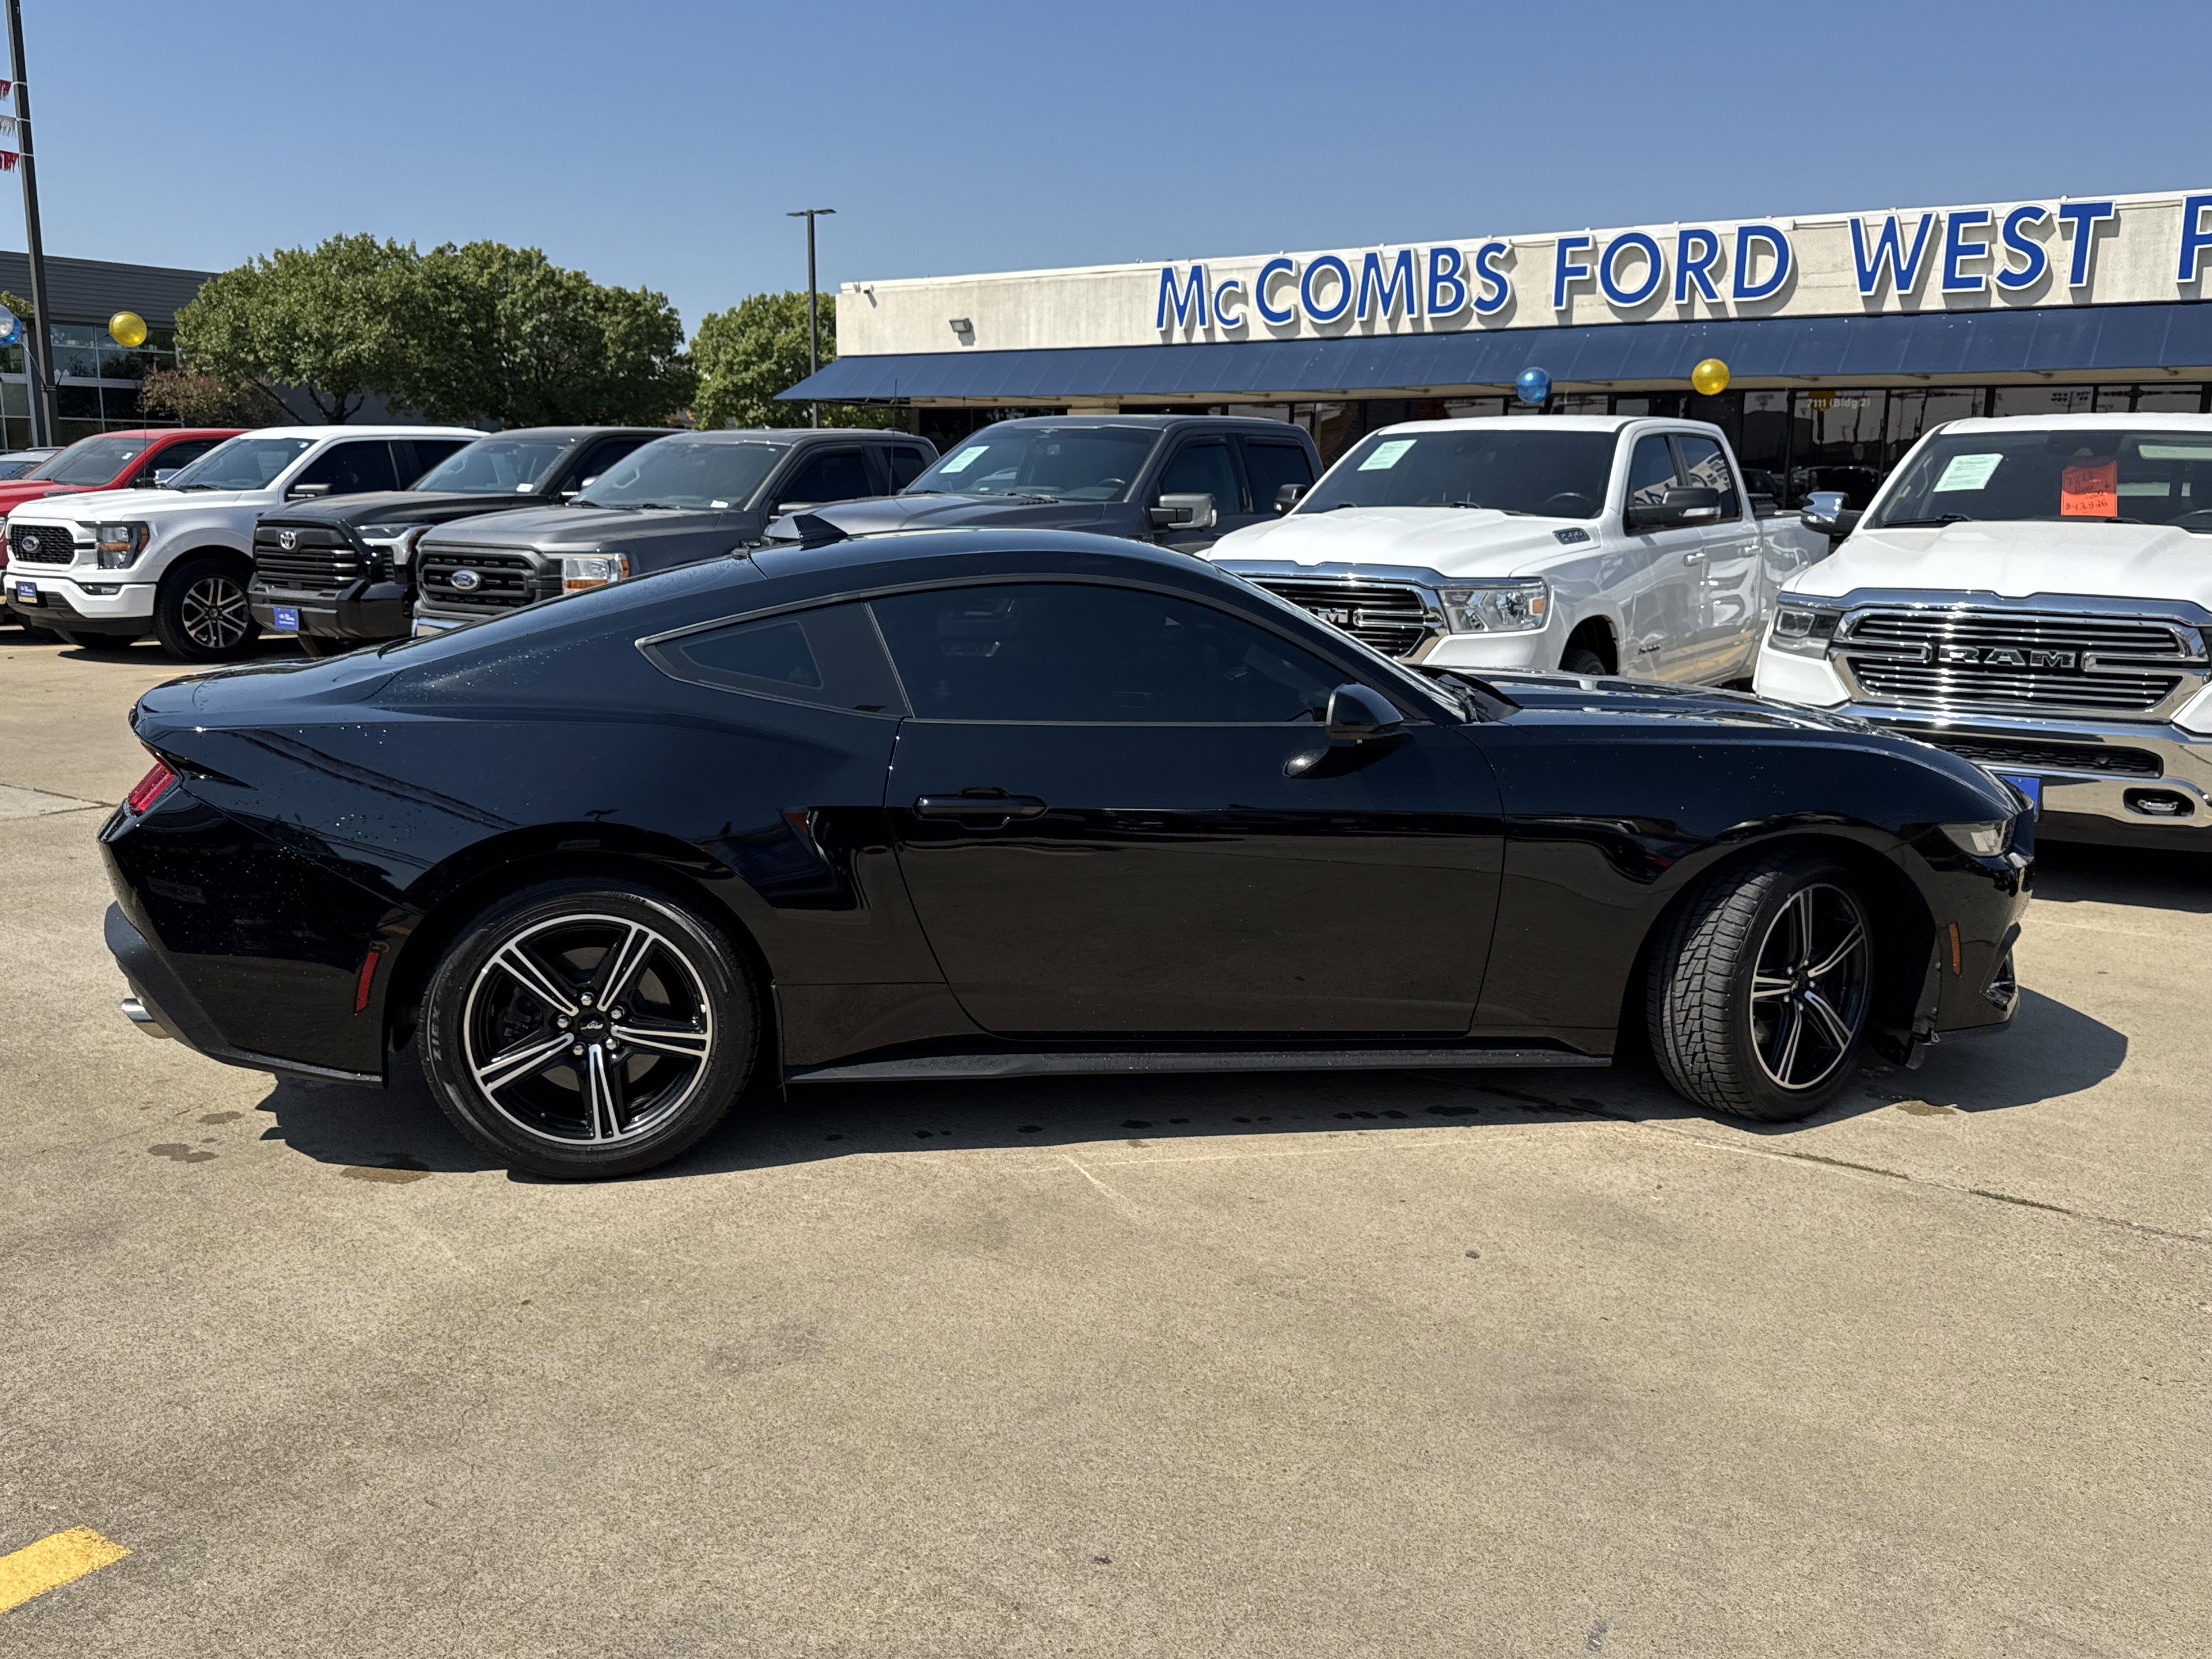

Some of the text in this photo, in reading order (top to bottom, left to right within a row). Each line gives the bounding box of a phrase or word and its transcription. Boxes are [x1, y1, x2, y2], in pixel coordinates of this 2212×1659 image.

[1553, 223, 1792, 310] FORD
[1848, 201, 2115, 296] WEST
[1807, 398, 1870, 409] 7111 (Bldg 2)
[1938, 644, 2076, 668] RAM
